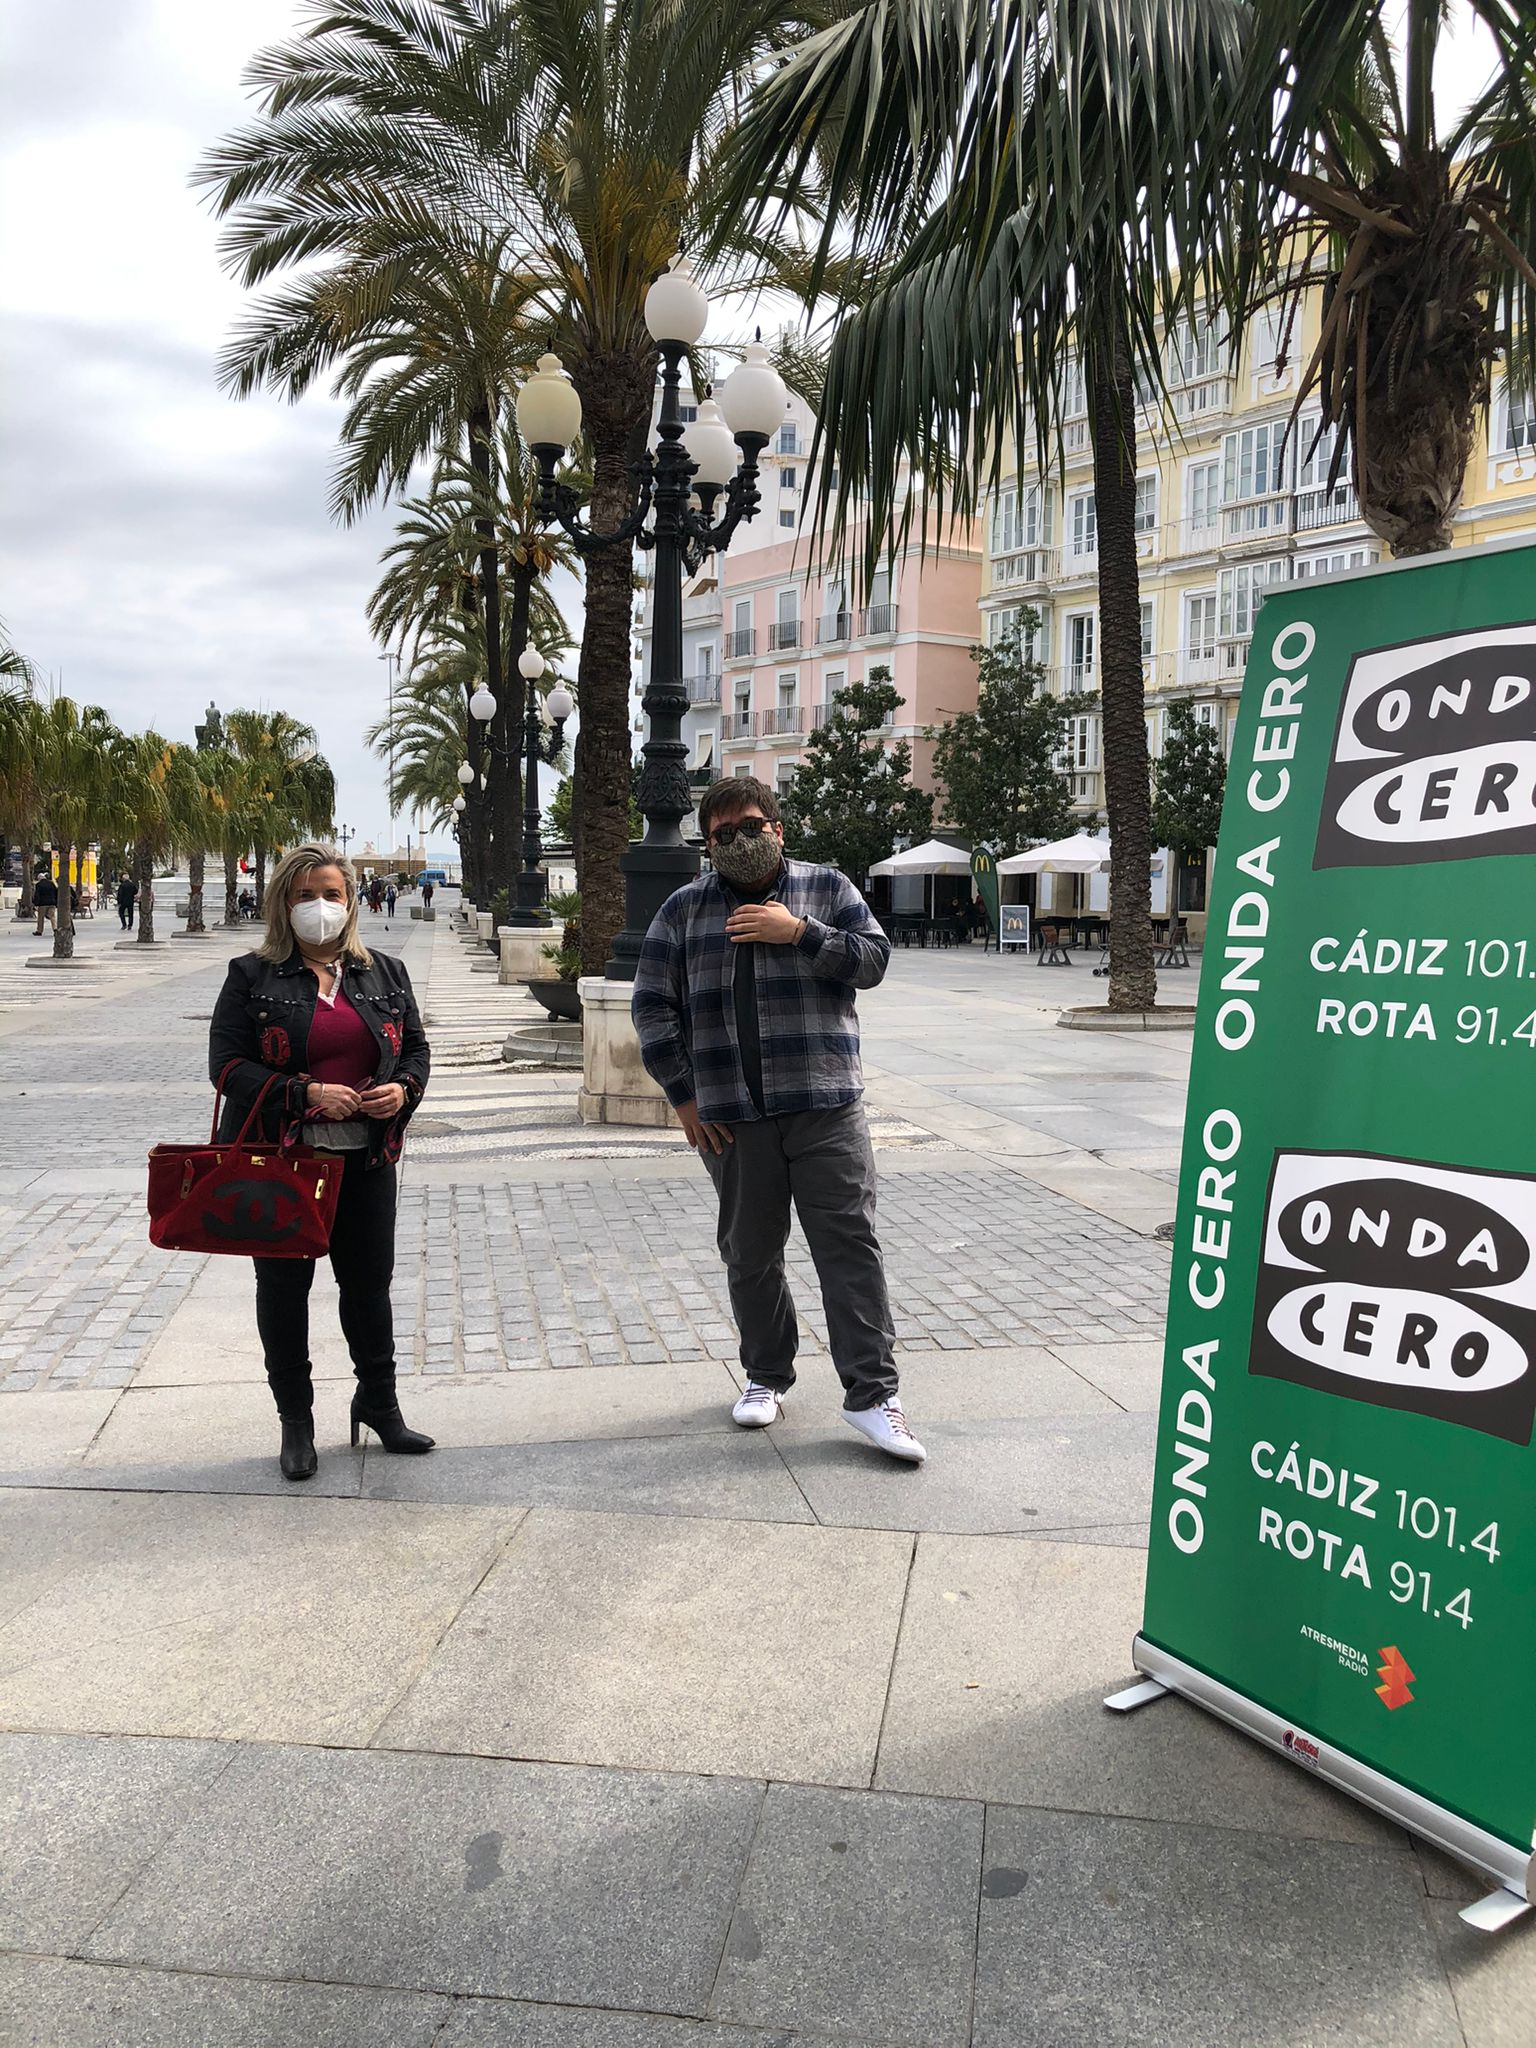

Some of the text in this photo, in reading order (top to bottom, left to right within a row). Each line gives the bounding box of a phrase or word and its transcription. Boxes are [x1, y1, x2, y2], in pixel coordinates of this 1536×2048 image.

[1376, 675, 1536, 733] OND
[1373, 762, 1536, 825] CER
[1309, 928, 1536, 978] CÁDIZ 101.
[1316, 998, 1536, 1048] ROTA 91.4
[1168, 621, 1316, 1554] ONDA CERO ONDA CERO
[1300, 1200, 1499, 1273] ONDA
[1299, 1293, 1490, 1378] CERO
[1251, 1440, 1501, 1564] CÁDIZ 101.4
[1258, 1506, 1473, 1630] ROTA 91.4
[1300, 1624, 1369, 1667] ATRESMEDIA
[1338, 1655, 1369, 1677] RADIO
